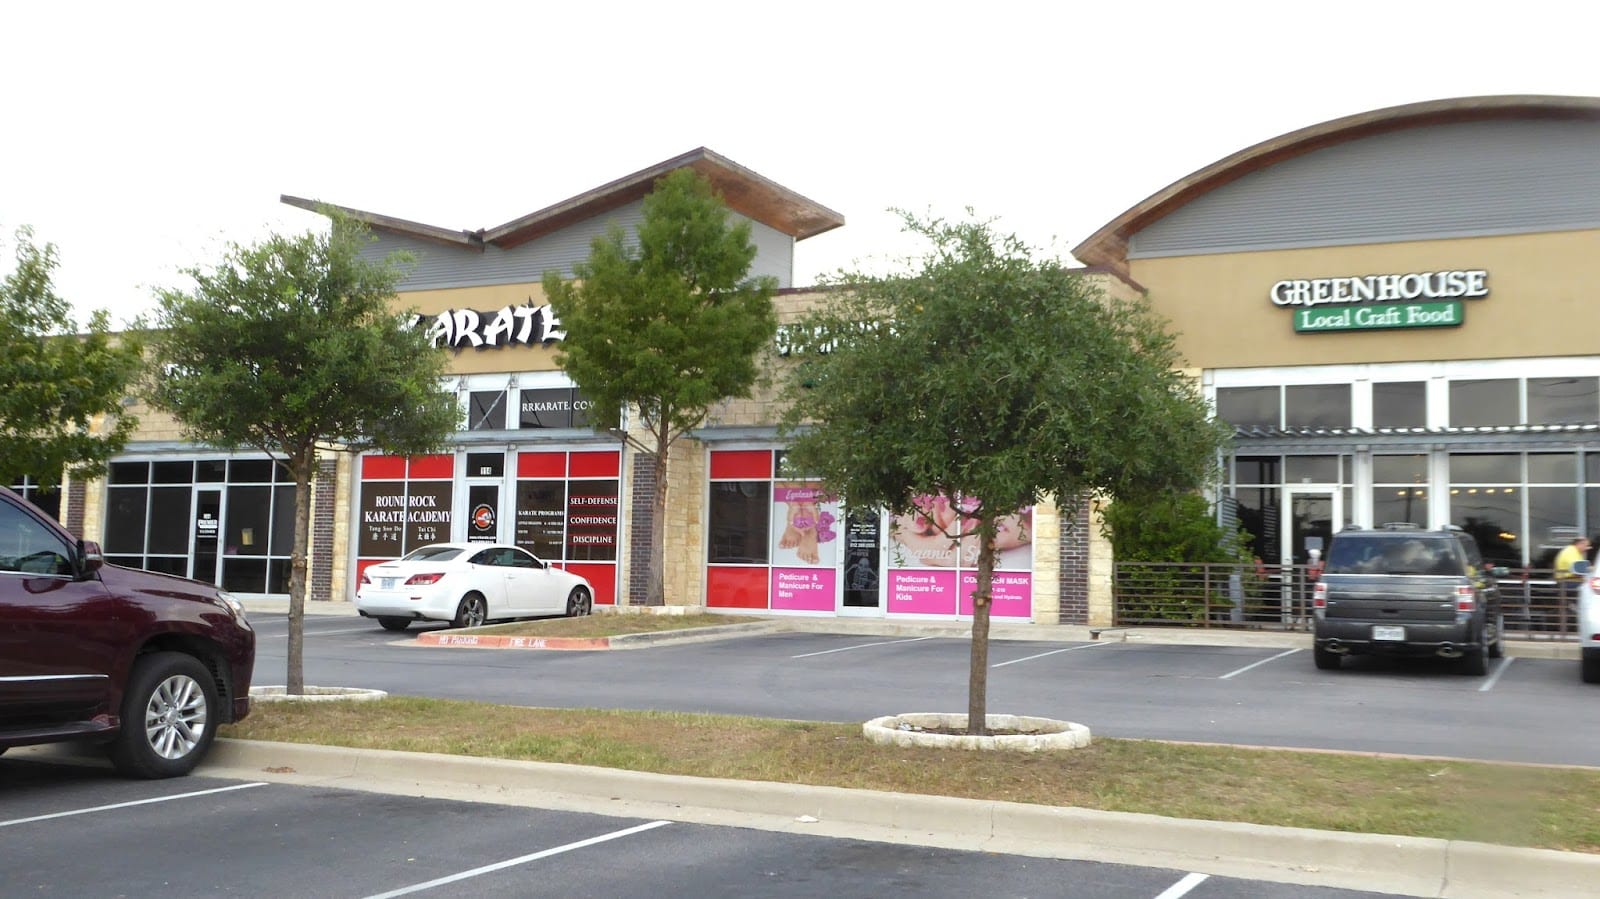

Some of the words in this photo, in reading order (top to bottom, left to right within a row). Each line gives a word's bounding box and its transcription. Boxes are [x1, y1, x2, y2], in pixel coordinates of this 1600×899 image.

[1270, 270, 1489, 306] GREENHOUSE
[1301, 309, 1350, 328] Local
[1354, 307, 1401, 326] Craft
[1405, 304, 1454, 324] Food
[375, 496, 405, 507] ROUND
[409, 495, 436, 507] ROCK
[570, 497, 618, 505] SELF-DEFENSE
[365, 511, 404, 522] KARATE
[407, 511, 451, 522] ACADEMY
[570, 516, 616, 524] CONFIDENCE
[573, 536, 612, 544] DISCIPLINE
[778, 573, 809, 581] Pedicure
[812, 573, 818, 581] &
[896, 575, 928, 583] Pedicure
[929, 575, 936, 583] &
[1006, 577, 1029, 585] MASK
[778, 581, 810, 589] Manicure
[811, 582, 824, 590] For
[895, 584, 929, 592] Manicure
[931, 585, 944, 593] For
[778, 590, 793, 598] Men
[895, 593, 913, 601] Kids
[528, 638, 547, 648] LANE
